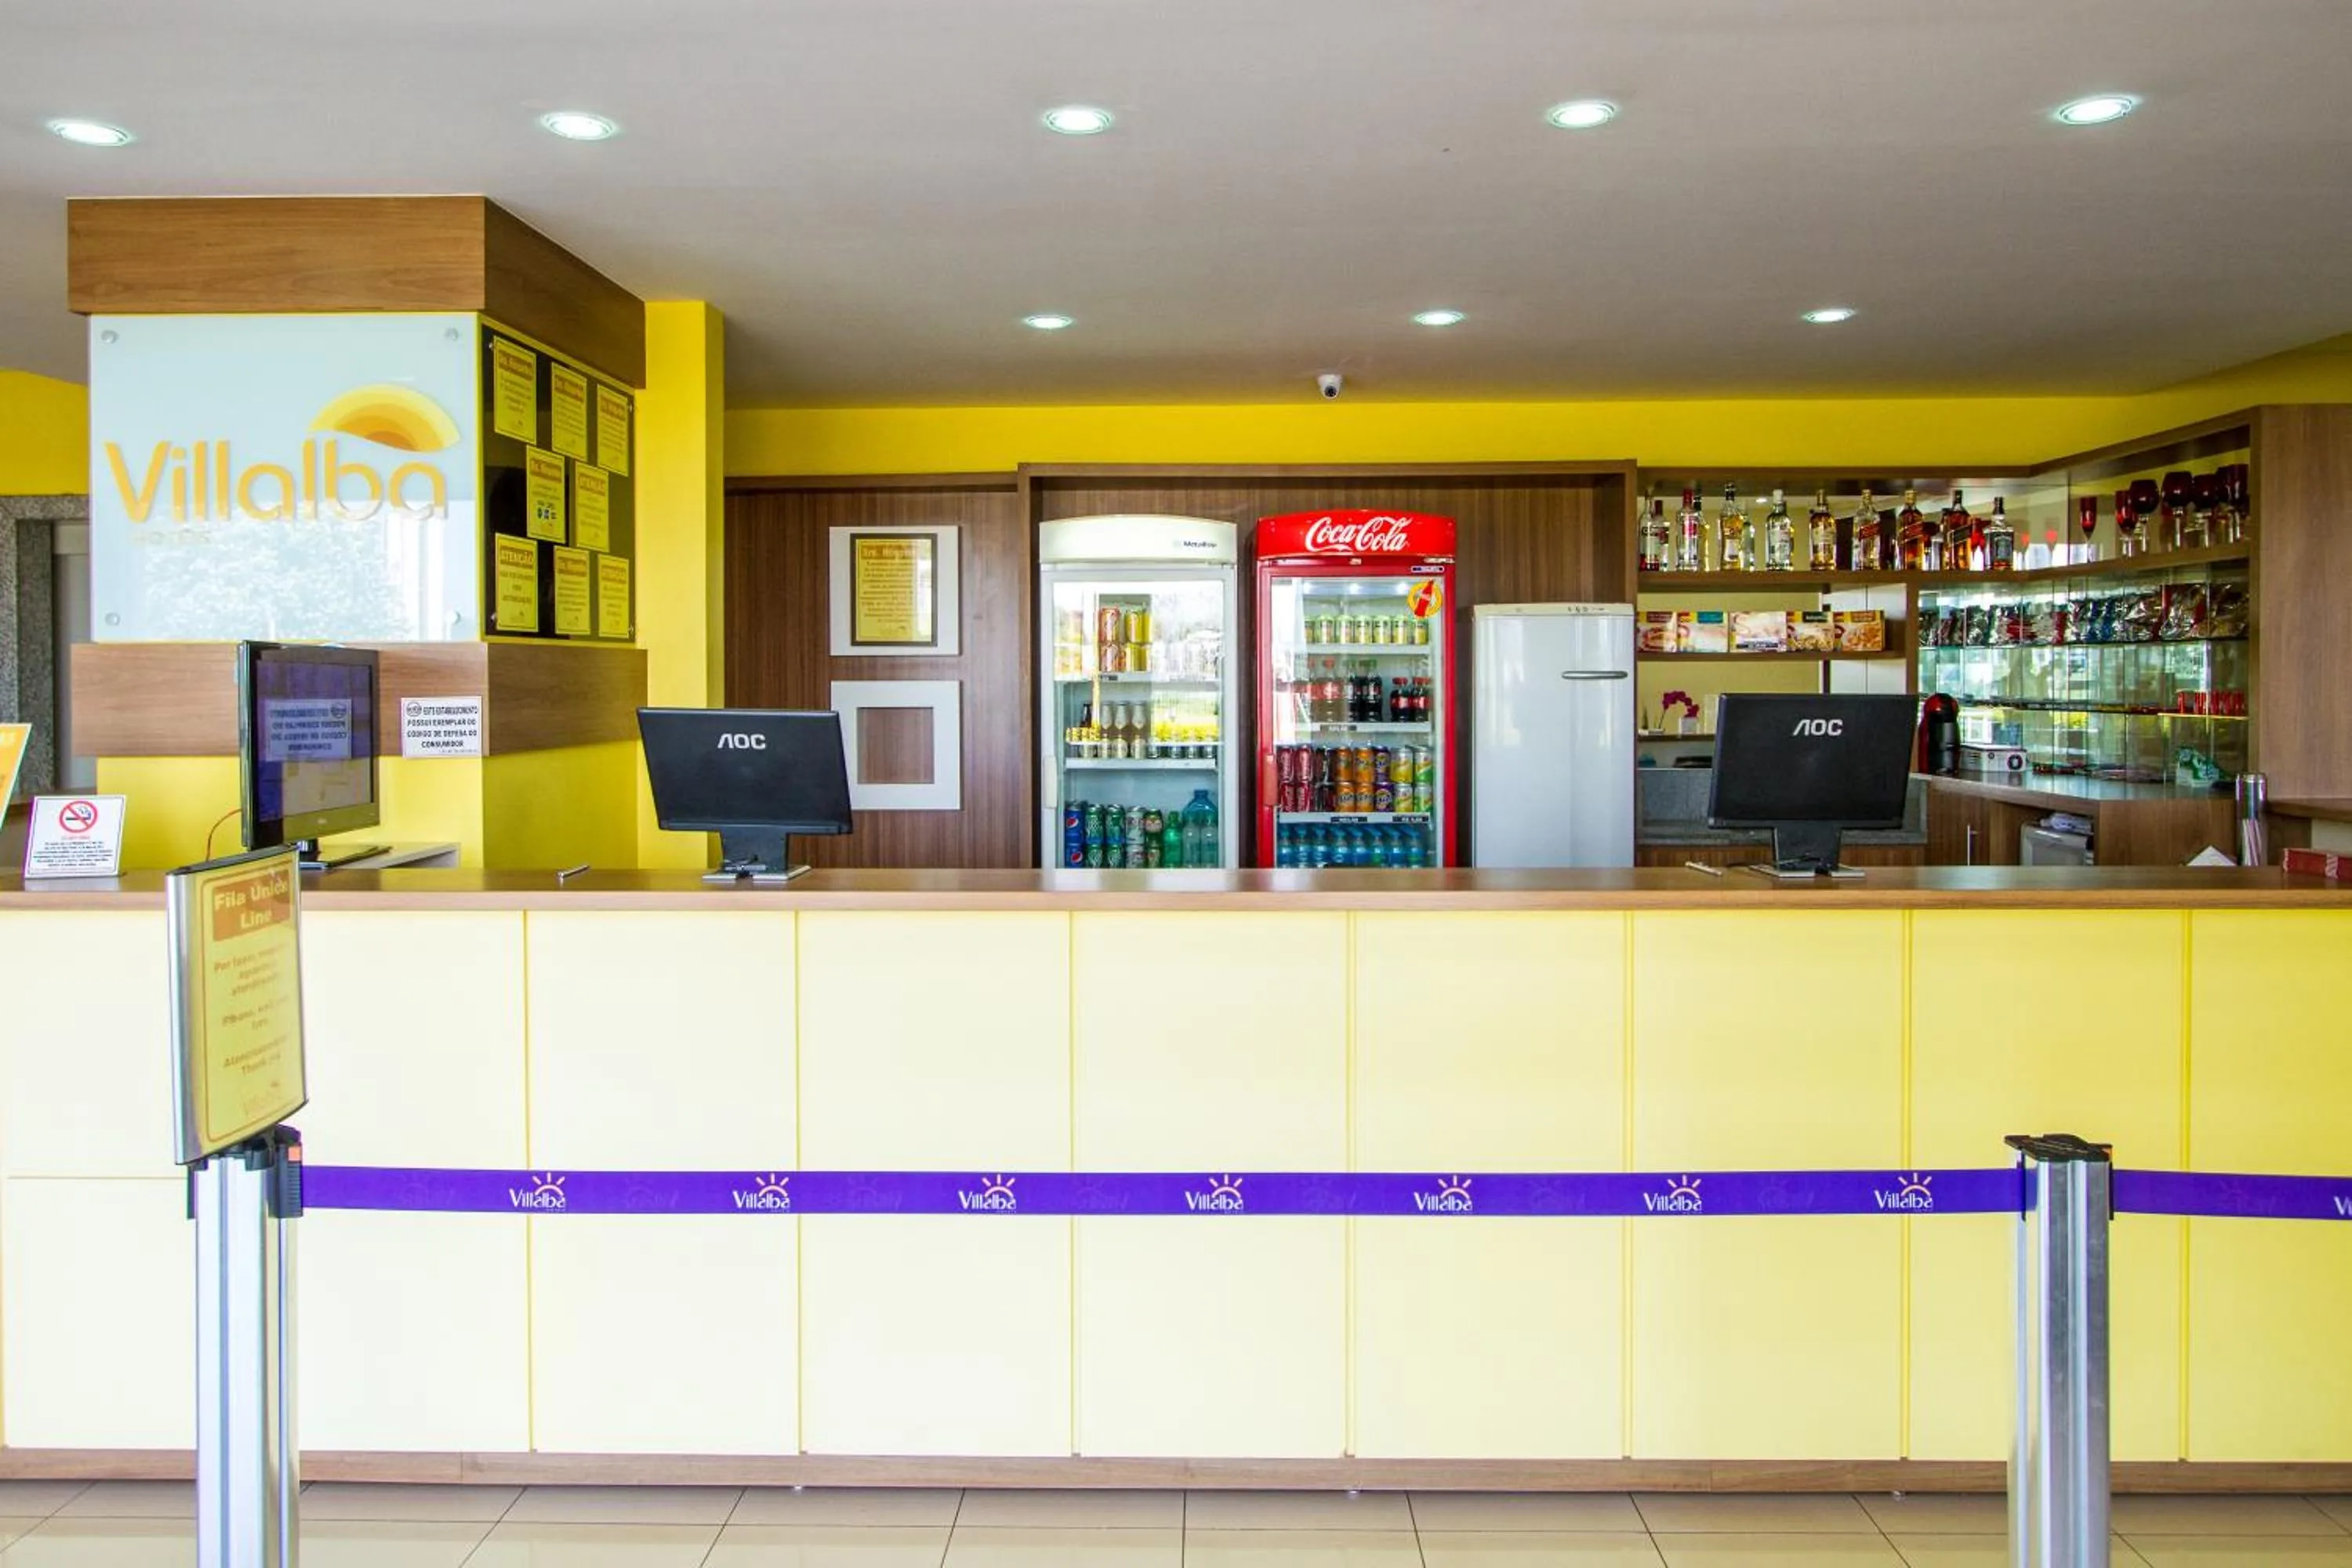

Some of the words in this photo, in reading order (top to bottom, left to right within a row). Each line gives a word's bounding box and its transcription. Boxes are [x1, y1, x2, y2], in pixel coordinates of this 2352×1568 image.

[104, 438, 448, 524] Villalba
[1305, 517, 1412, 552] Coca-Cola
[1792, 718, 1843, 737] AOC
[717, 733, 766, 750] AOC
[214, 891, 247, 911] Fila
[509, 1188, 565, 1208] Villalba
[732, 1190, 790, 1209] Villalba
[958, 1190, 1017, 1210] Villalba
[1185, 1191, 1243, 1210] Villalba
[1414, 1192, 1473, 1211] Villalba
[1643, 1192, 1702, 1212] Villalba
[1874, 1189, 1933, 1210] Villalba
